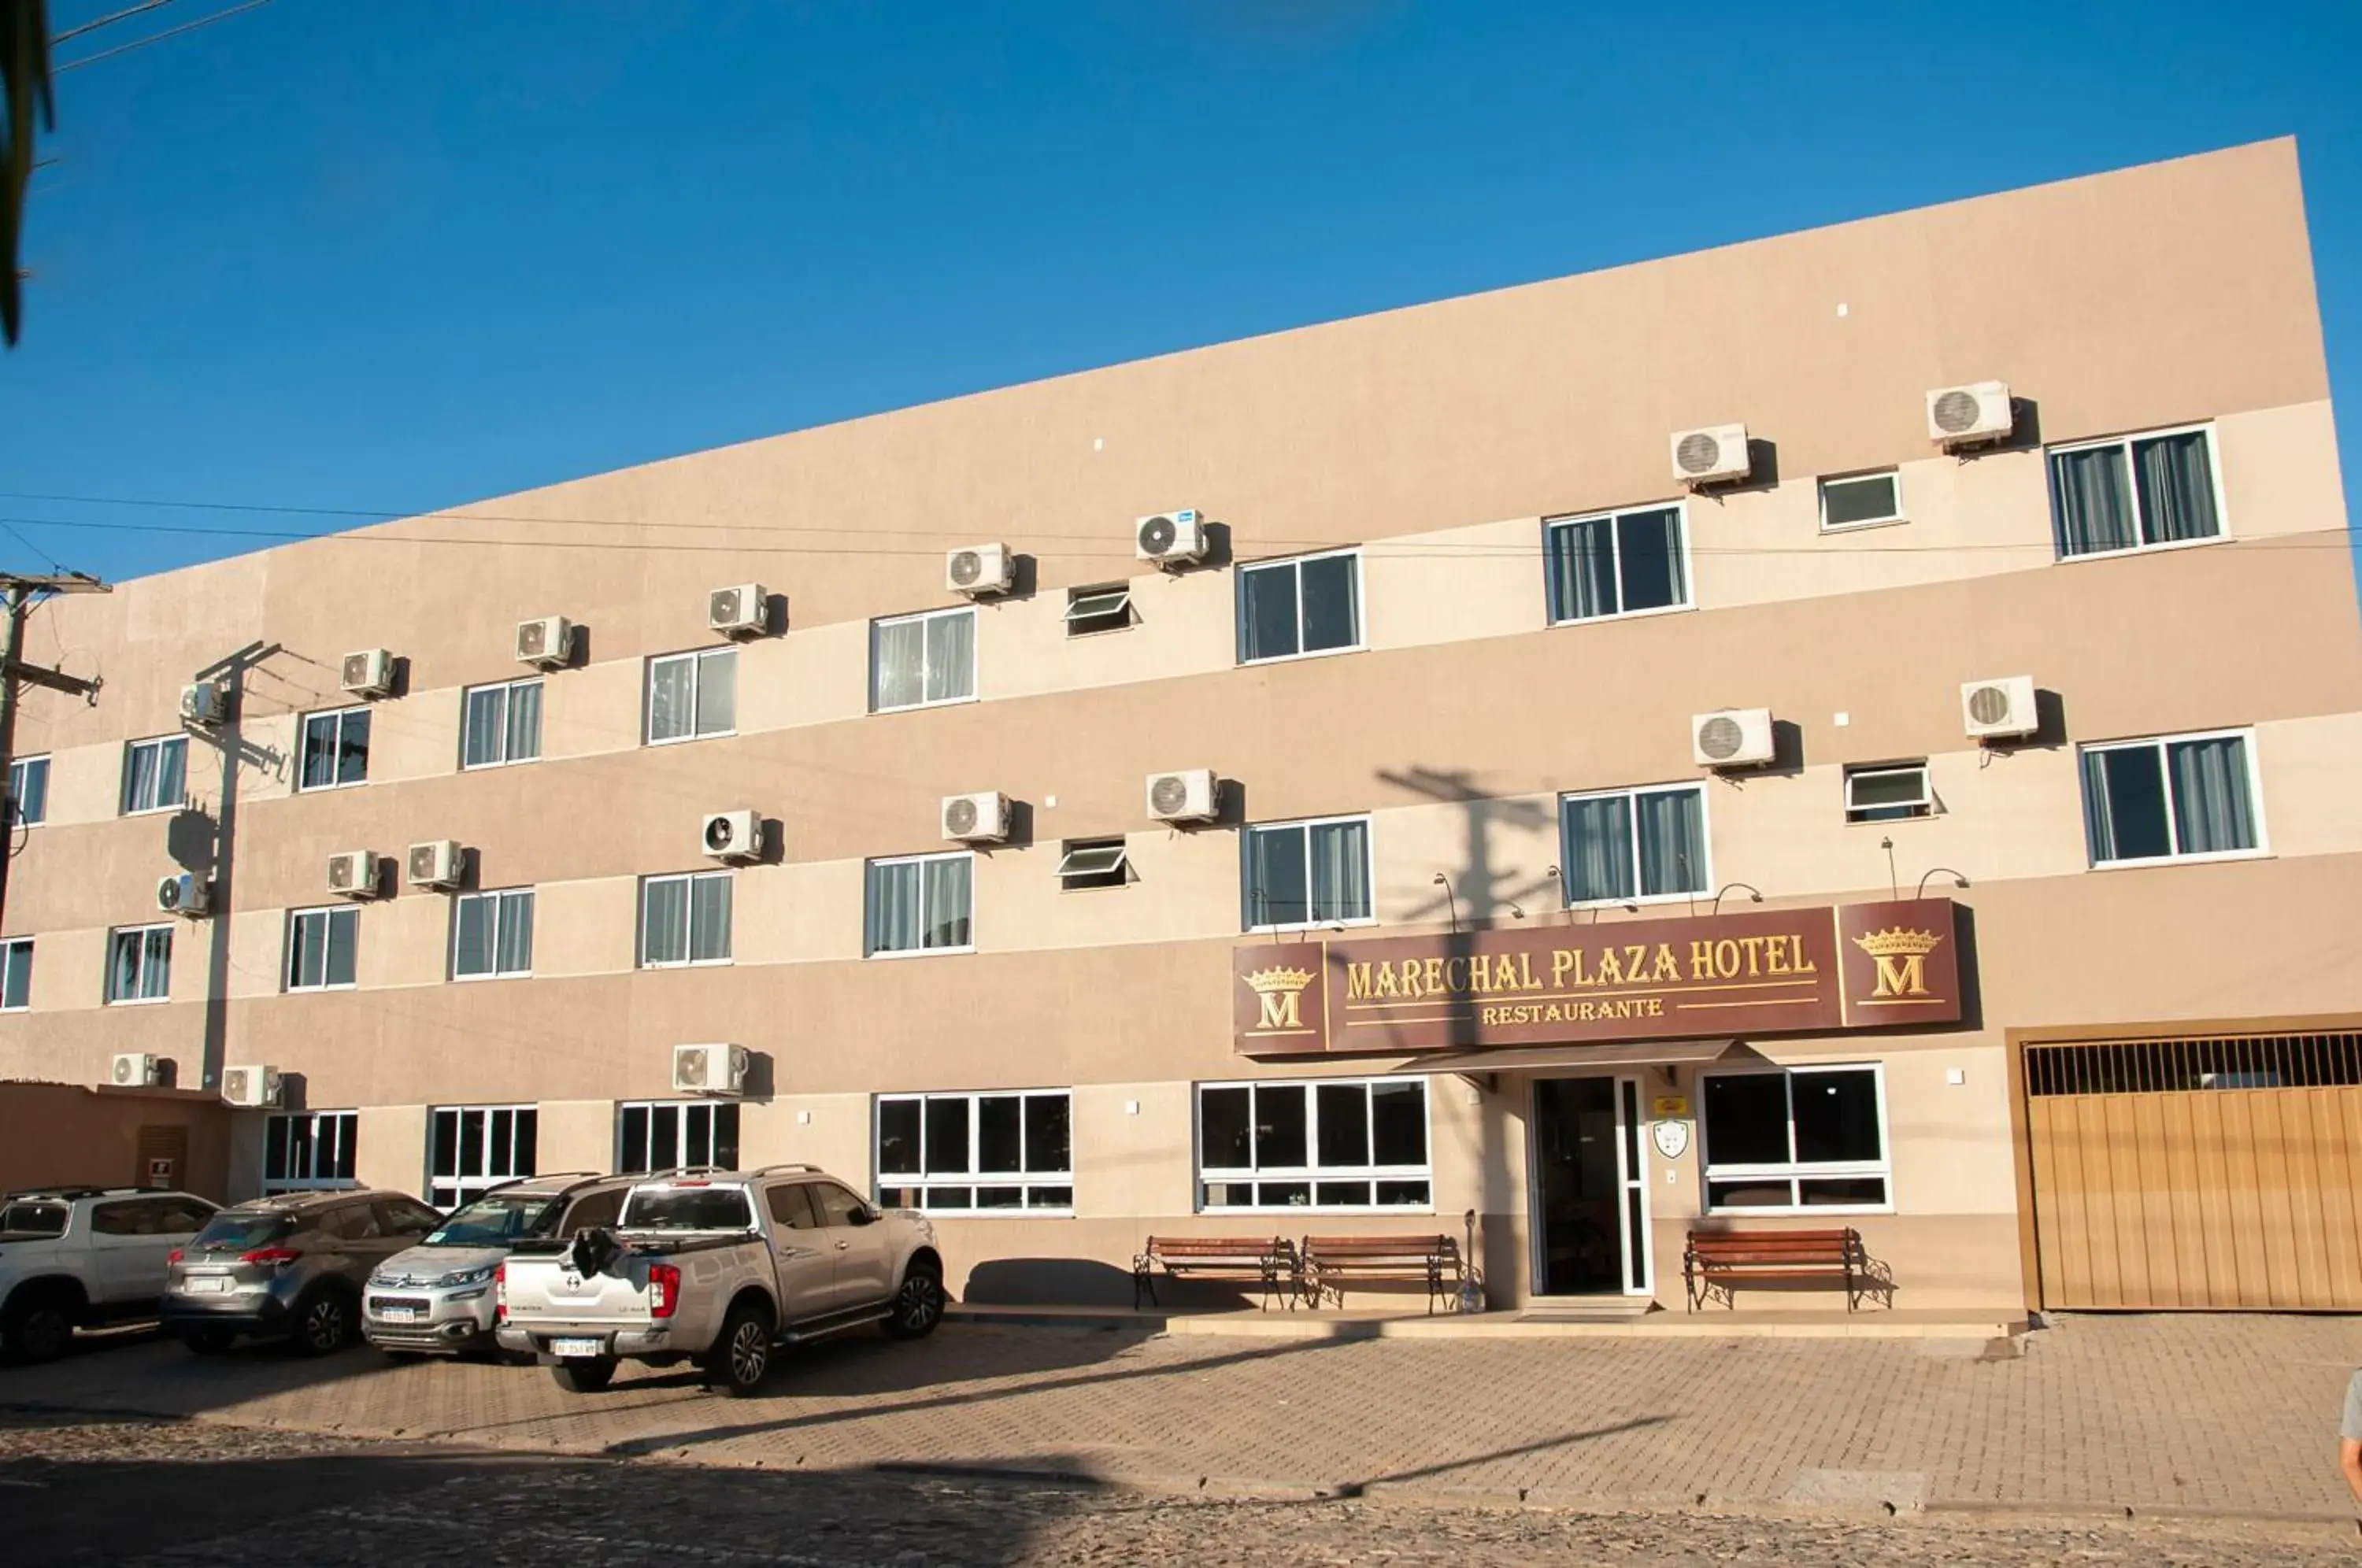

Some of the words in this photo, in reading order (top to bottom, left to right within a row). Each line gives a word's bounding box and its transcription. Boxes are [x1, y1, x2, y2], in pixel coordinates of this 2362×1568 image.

[1346, 952, 1543, 1000] MARECHAL
[1552, 944, 1682, 987] PLAZA
[1690, 934, 1816, 982] HOTEL
[1872, 955, 1931, 997] M
[1256, 990, 1304, 1029] M
[1482, 997, 1664, 1026] RESTAURANTE
